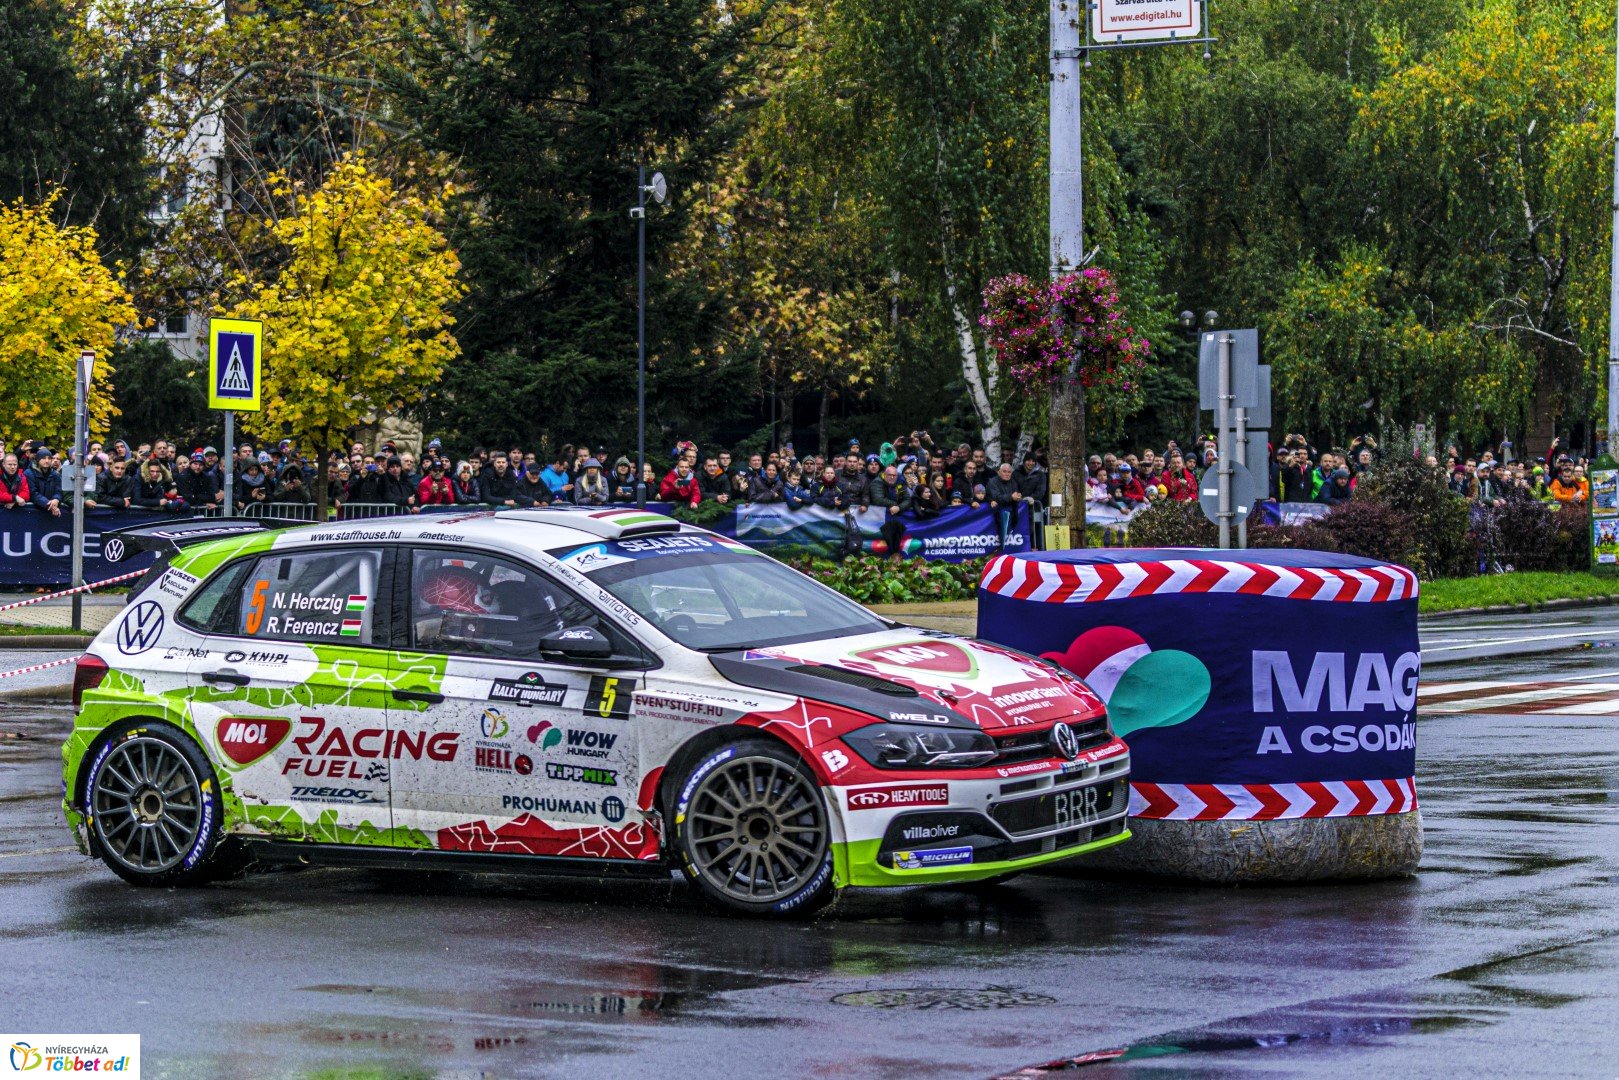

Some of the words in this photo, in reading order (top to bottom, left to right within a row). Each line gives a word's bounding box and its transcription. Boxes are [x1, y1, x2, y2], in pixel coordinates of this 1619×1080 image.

[1110, 10, 1182, 22] www.edigital.hu
[310, 530, 402, 541] www.staffhouse.hu
[617, 536, 713, 552] SEAJETS
[245, 580, 270, 635] 5
[272, 592, 287, 609] N.
[289, 593, 344, 615] Herczig
[266, 617, 281, 634] R.
[283, 617, 338, 636] Ferencz
[248, 651, 289, 664] KNIPL
[874, 645, 950, 665] MOL
[492, 683, 520, 698] RALLY
[520, 689, 565, 703] HUNGARY
[598, 677, 619, 718] 5
[635, 695, 725, 717] EVENTSTUFF.HU
[223, 722, 268, 744] MOL
[292, 716, 461, 762] RACING
[568, 729, 618, 750] WOW
[1256, 726, 1293, 755] A
[475, 747, 512, 770] HELL
[567, 747, 610, 759] HUNGARY
[281, 757, 364, 780] FUEL
[502, 795, 597, 815] PROHUMAN
[891, 789, 920, 803] HEAVY
[919, 788, 948, 801] TOOLS
[1055, 786, 1100, 829] BRR
[903, 825, 960, 839] villaoliver
[922, 851, 971, 862] MICHELIN
